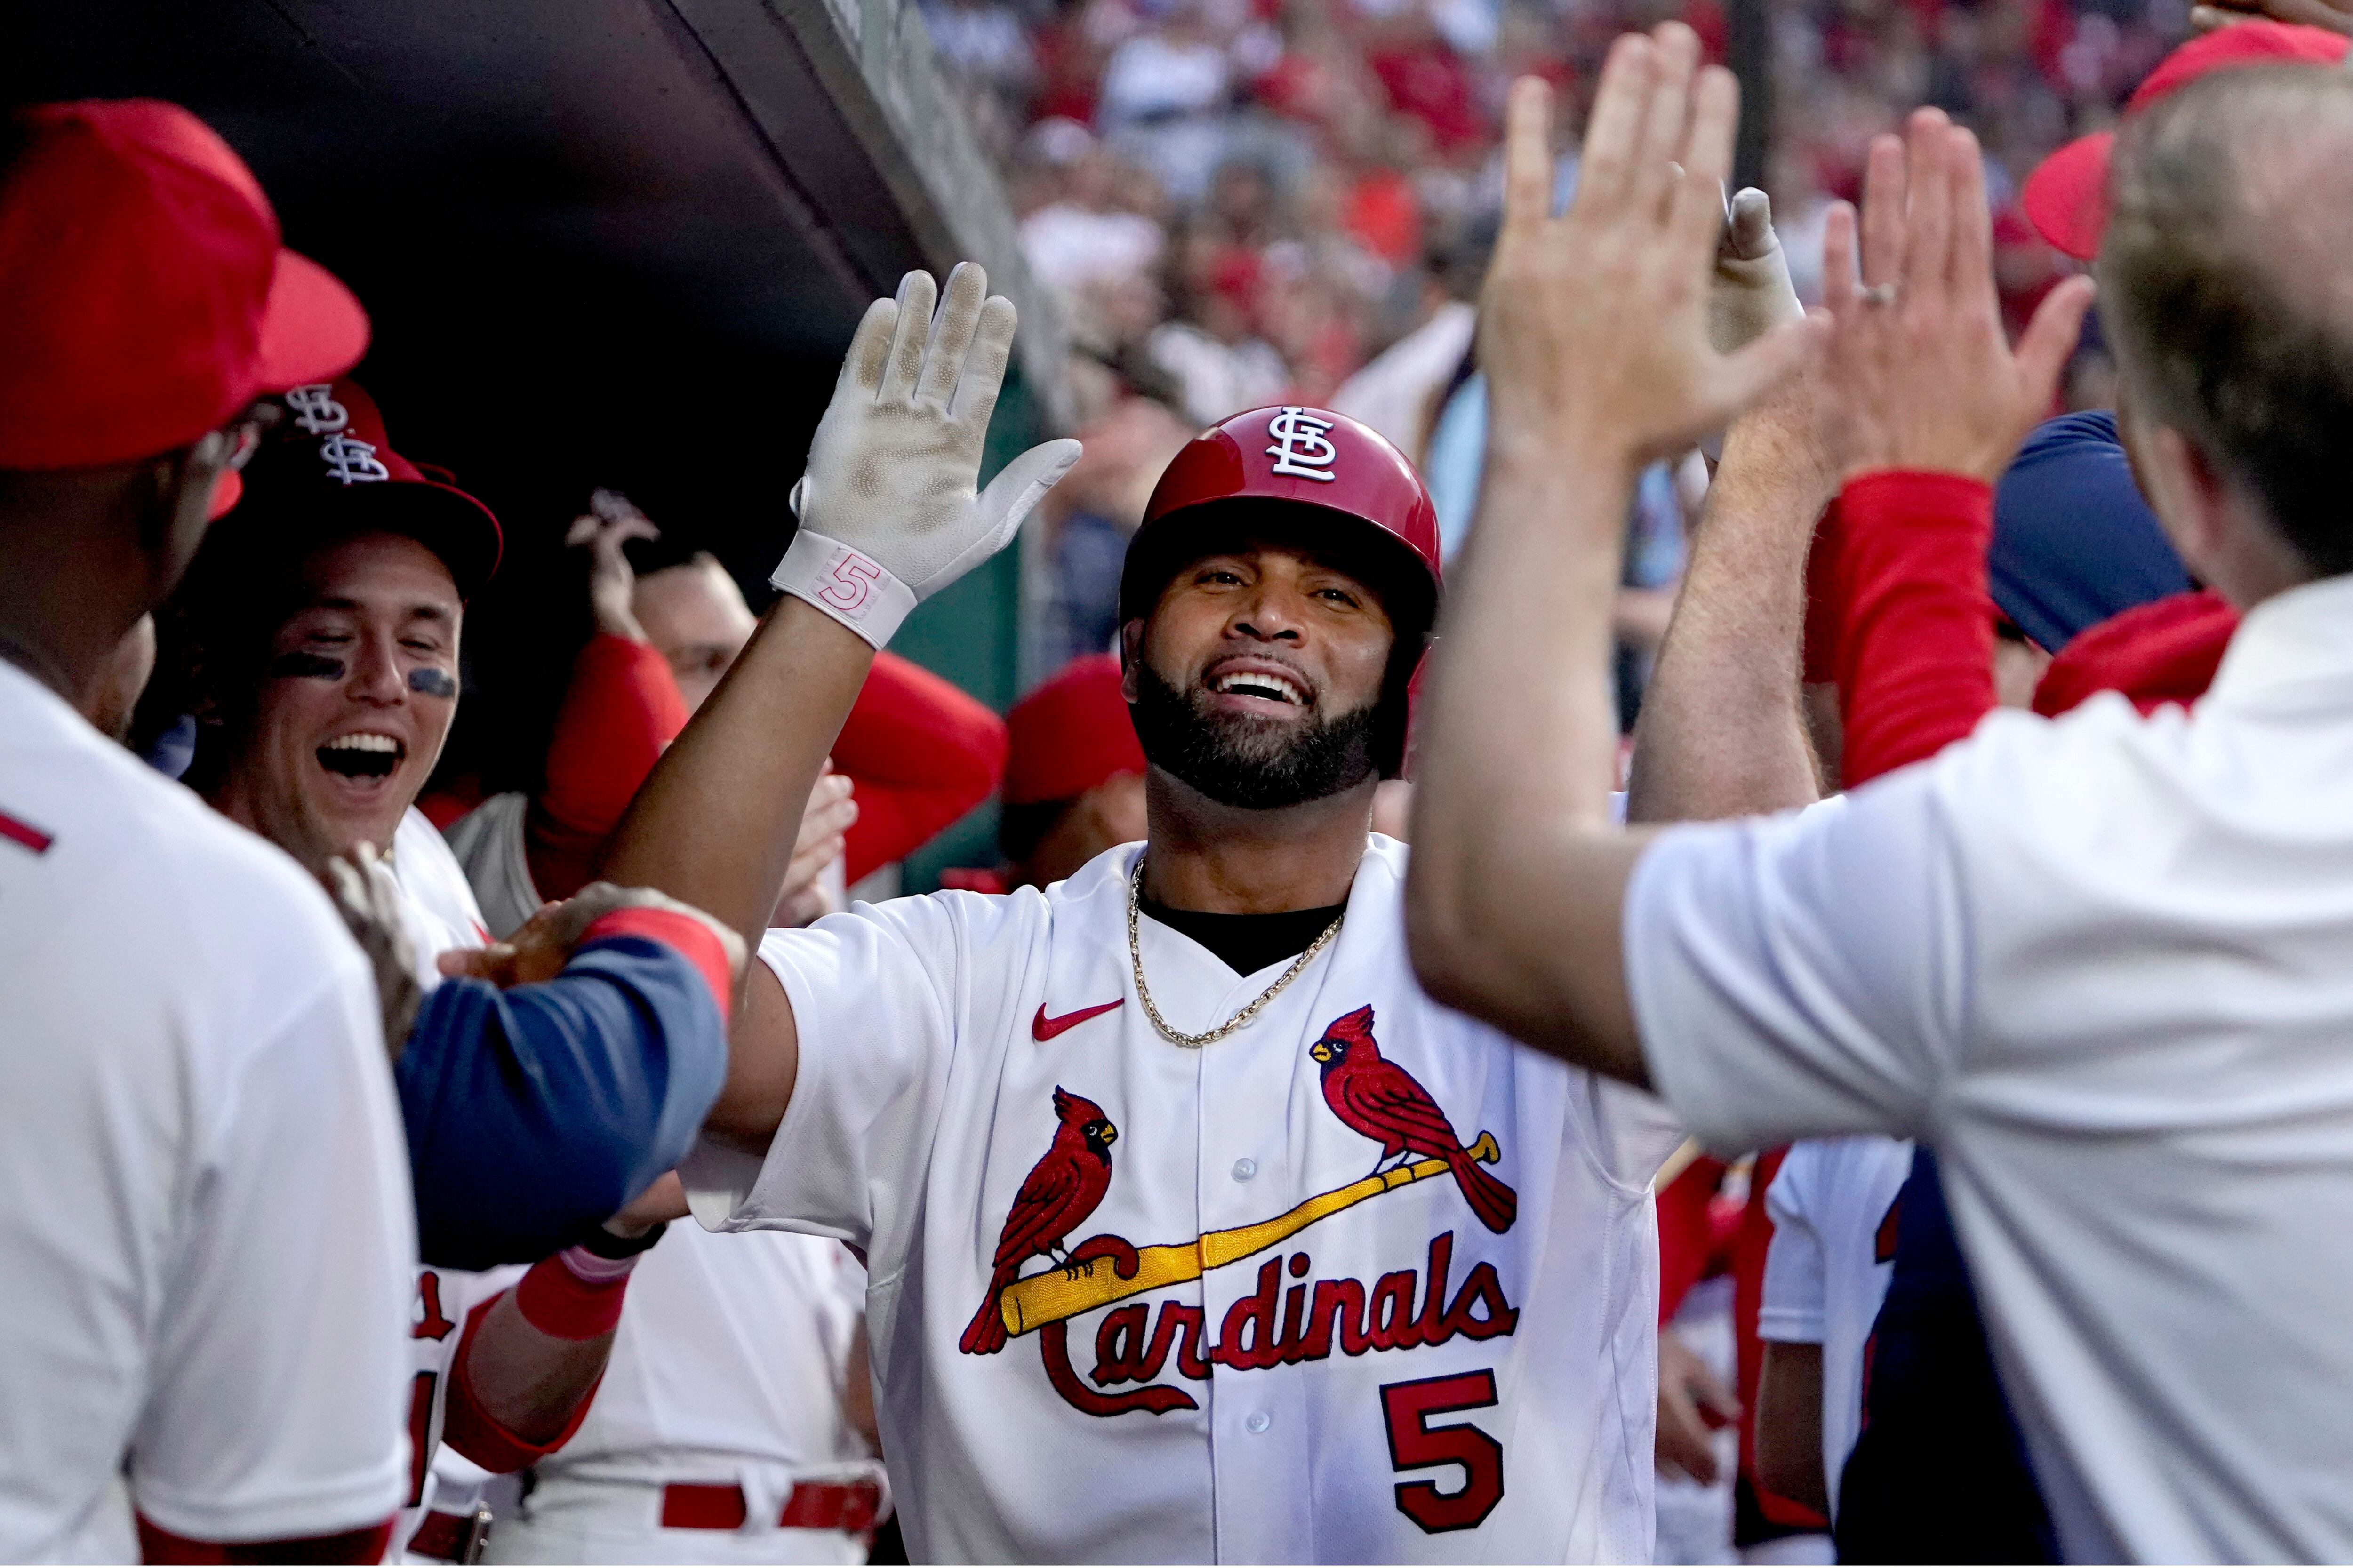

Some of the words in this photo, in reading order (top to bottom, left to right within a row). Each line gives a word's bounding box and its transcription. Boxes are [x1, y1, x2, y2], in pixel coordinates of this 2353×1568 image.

[819, 553, 880, 610] 5
[1040, 1231, 1520, 1416] Cardinals
[1380, 1368, 1505, 1534] 5
